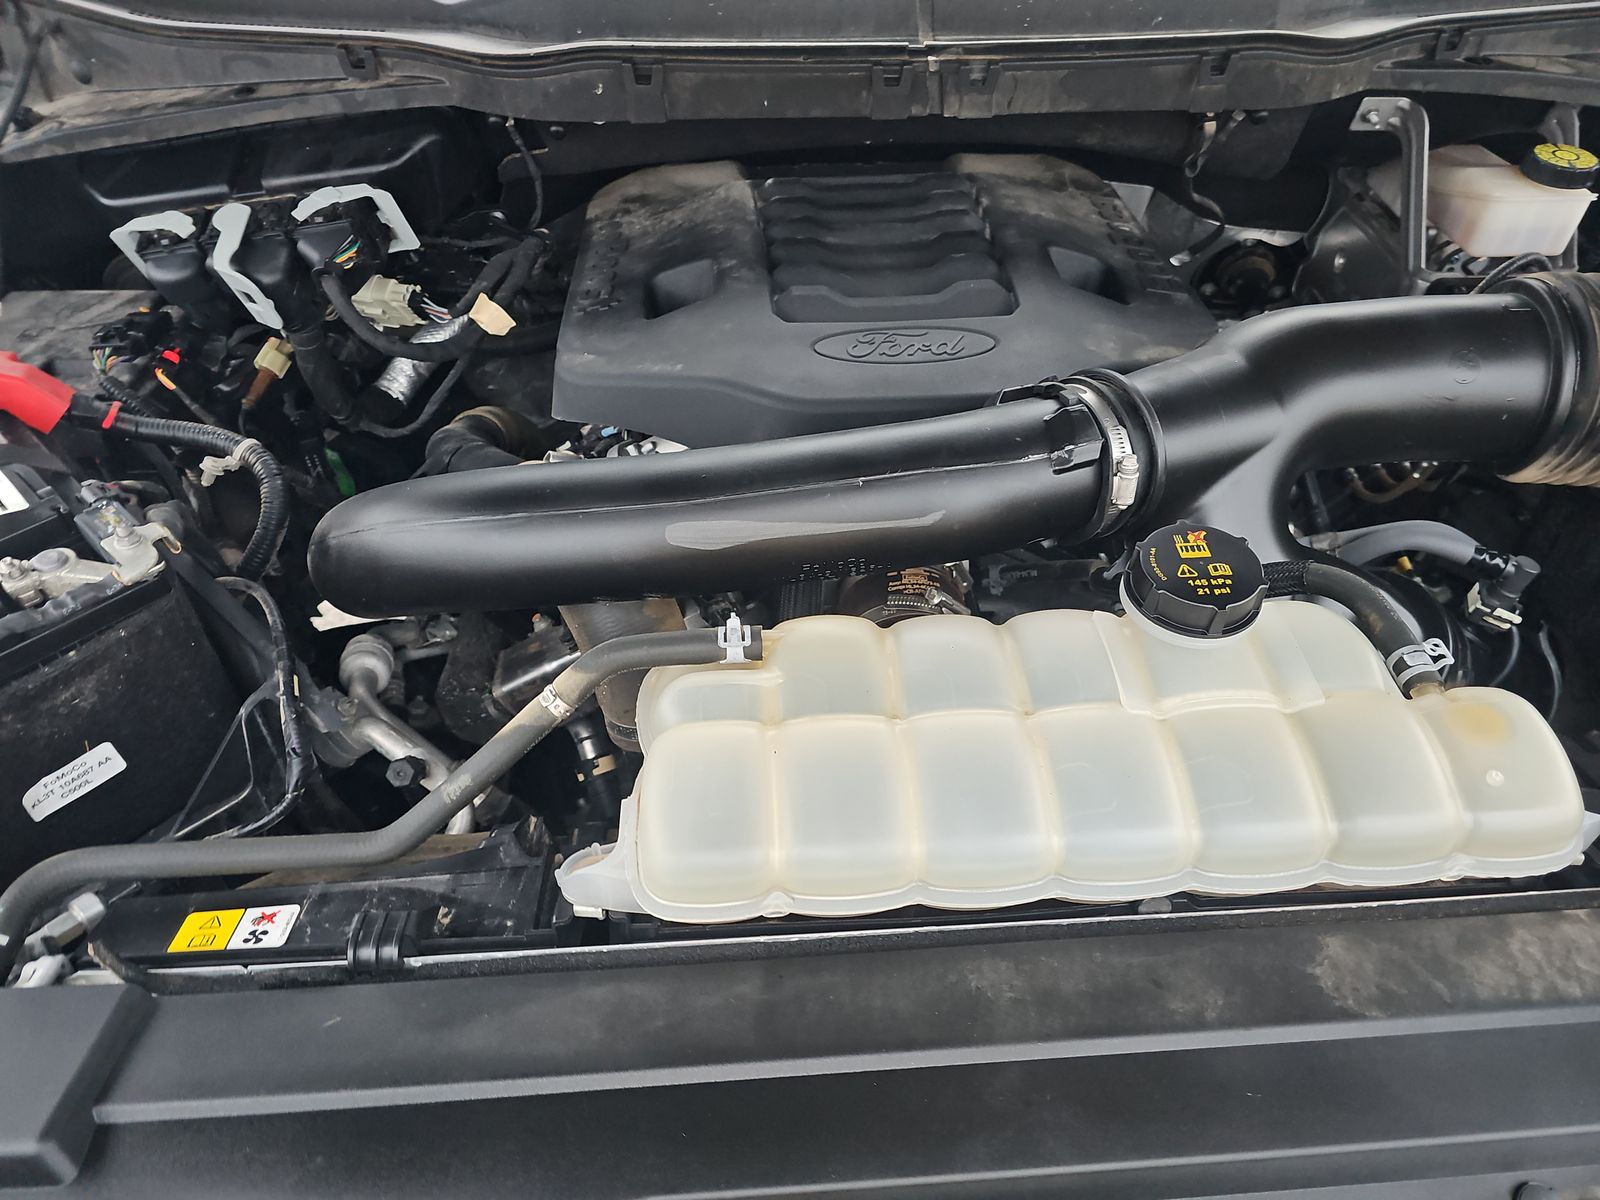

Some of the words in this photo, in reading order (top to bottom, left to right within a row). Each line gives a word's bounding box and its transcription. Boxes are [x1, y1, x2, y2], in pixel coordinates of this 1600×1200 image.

[846, 331, 965, 358] Ford
[1188, 579, 1208, 587] 145
[1210, 578, 1232, 586] kPa
[1196, 587, 1210, 595] 21
[1214, 586, 1231, 595] psi
[98, 756, 112, 768] AA
[43, 761, 87, 789] FoMoCo
